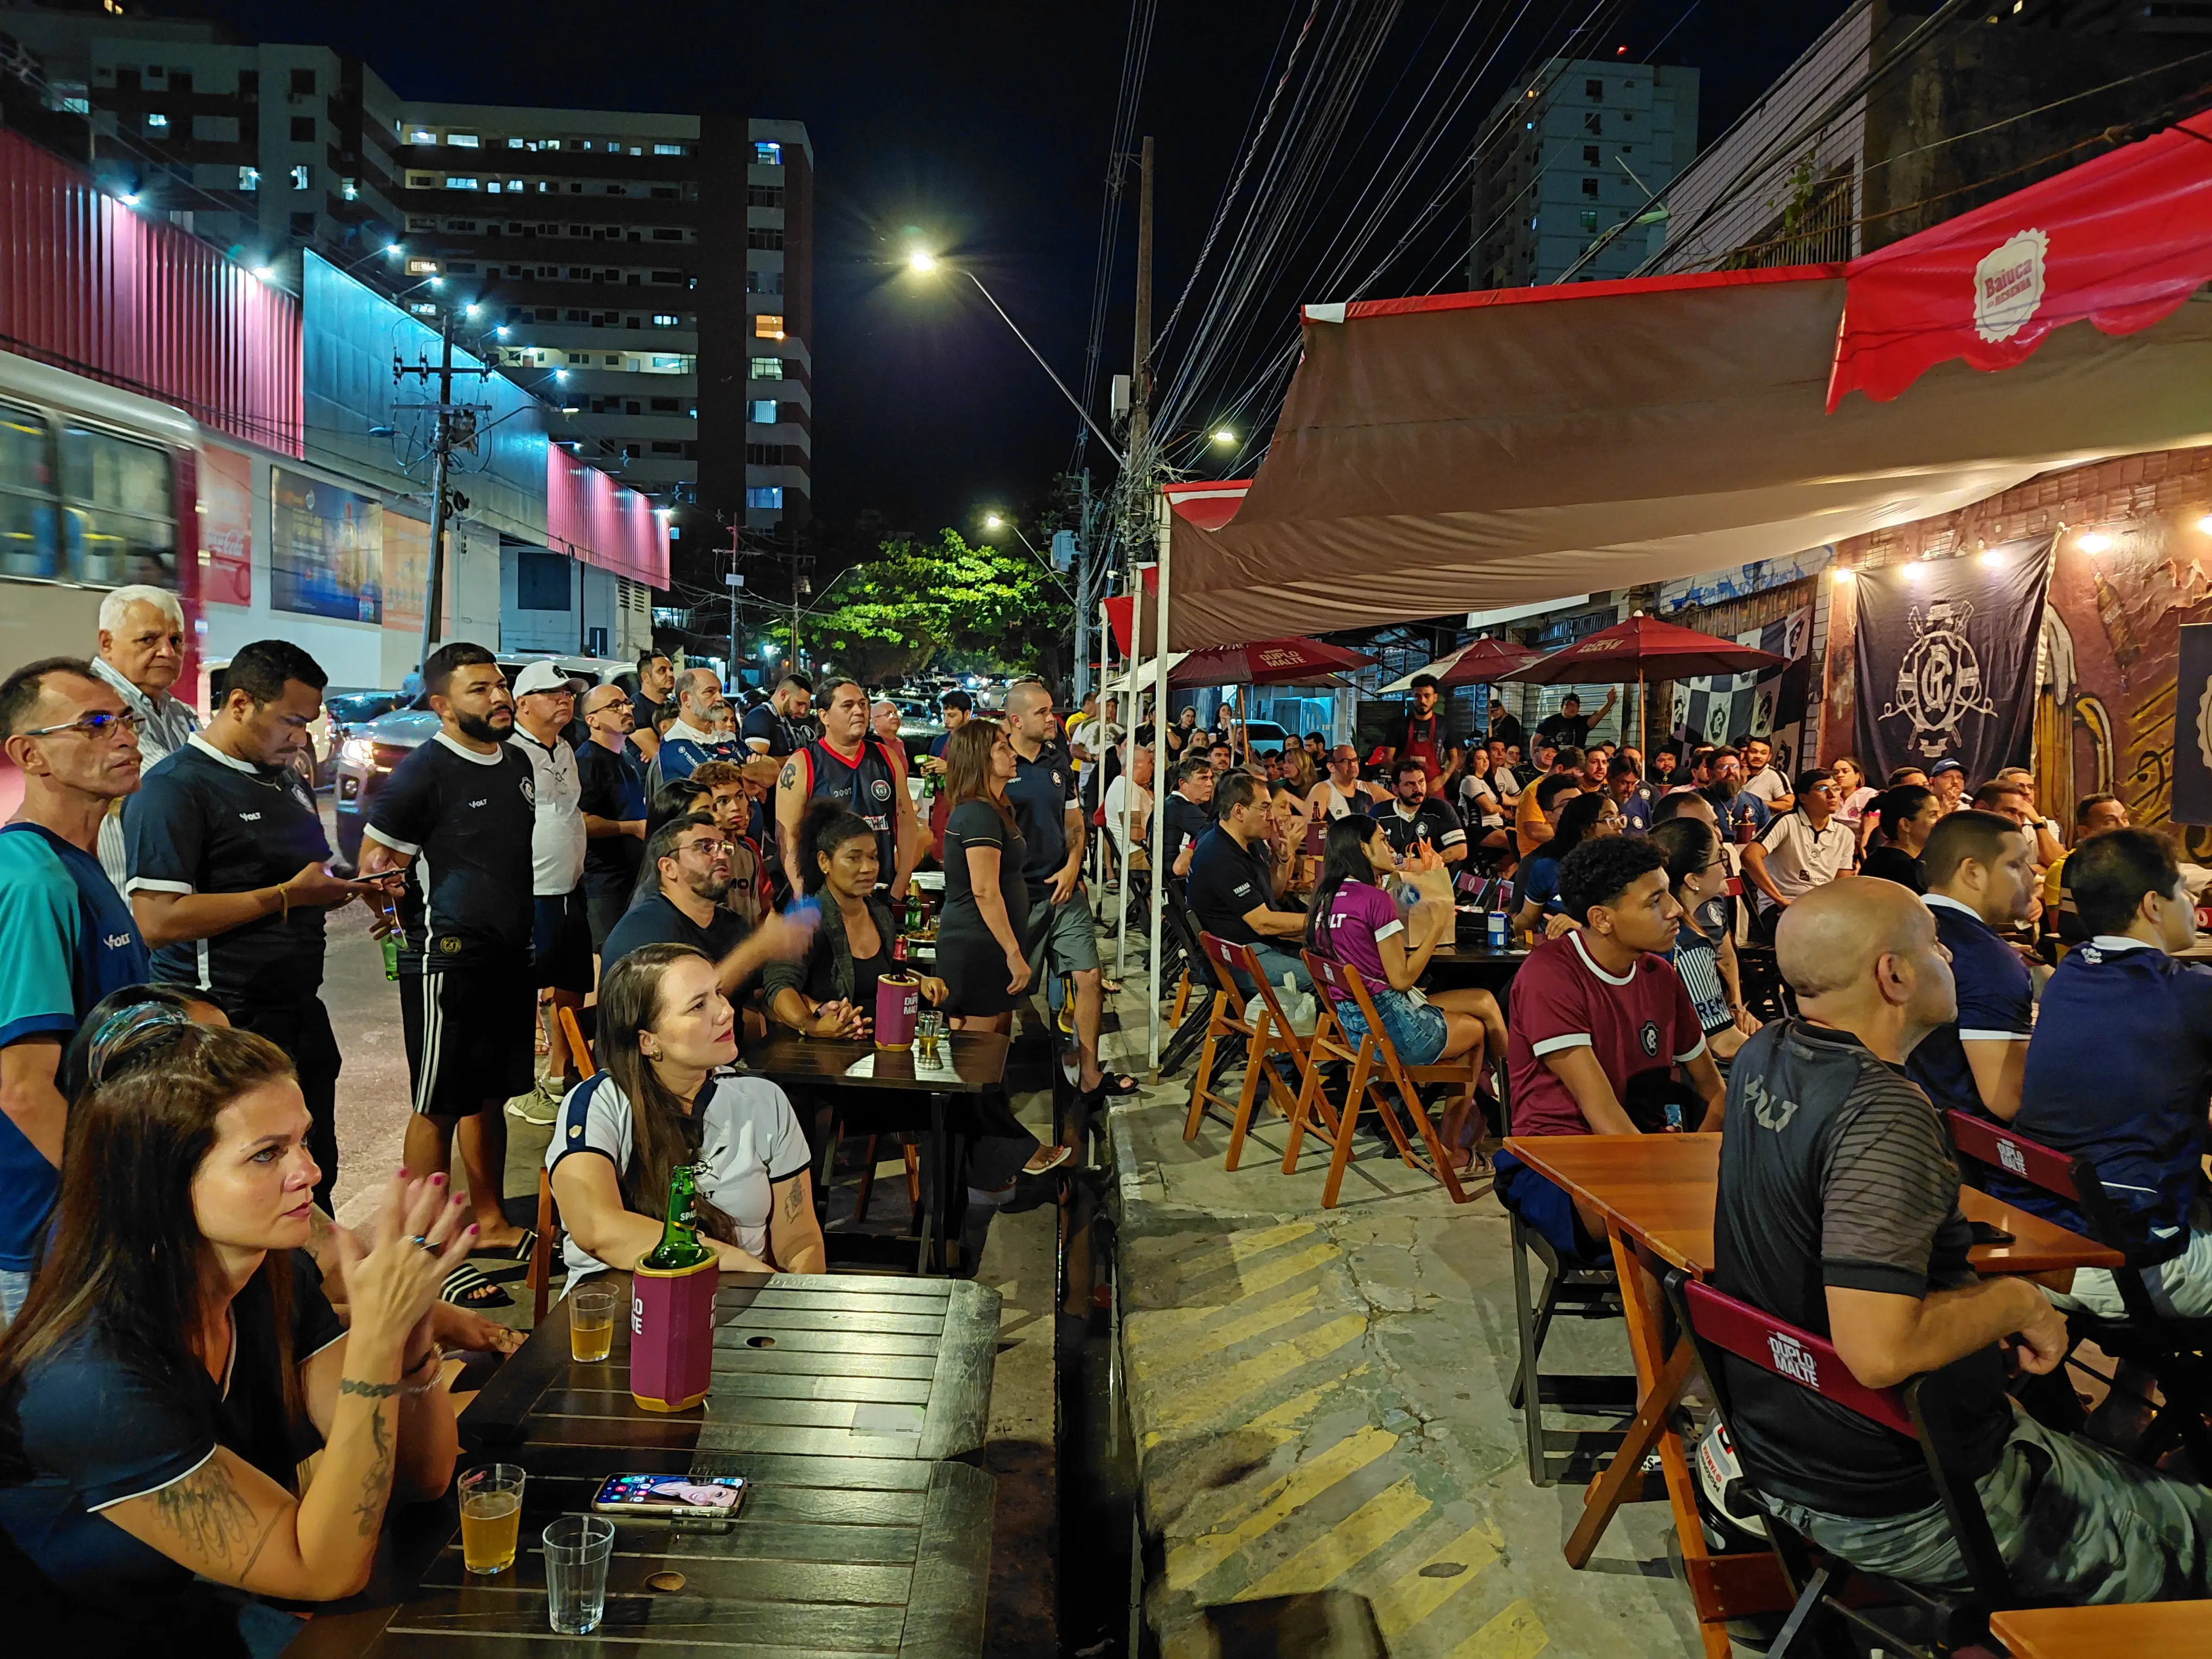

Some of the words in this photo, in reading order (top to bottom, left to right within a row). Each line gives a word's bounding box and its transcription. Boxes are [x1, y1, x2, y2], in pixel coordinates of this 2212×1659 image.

[1985, 259, 2031, 299] Baiuca
[1258, 651, 1300, 661] DUPLO
[1265, 657, 1307, 667] MALTE
[833, 787, 852, 798] 2007
[468, 799, 487, 809] VOLT
[239, 812, 261, 822] VOLT
[1232, 882, 1251, 895] YAMAHA
[103, 933, 130, 950] VOLT
[1997, 1142, 2024, 1164] DUPLO
[2001, 1154, 2028, 1175] MALTE
[1769, 1336, 1815, 1370] DUPLO
[1773, 1354, 1819, 1387] MALTE
[1703, 1444, 1717, 1475] YAMAHA
